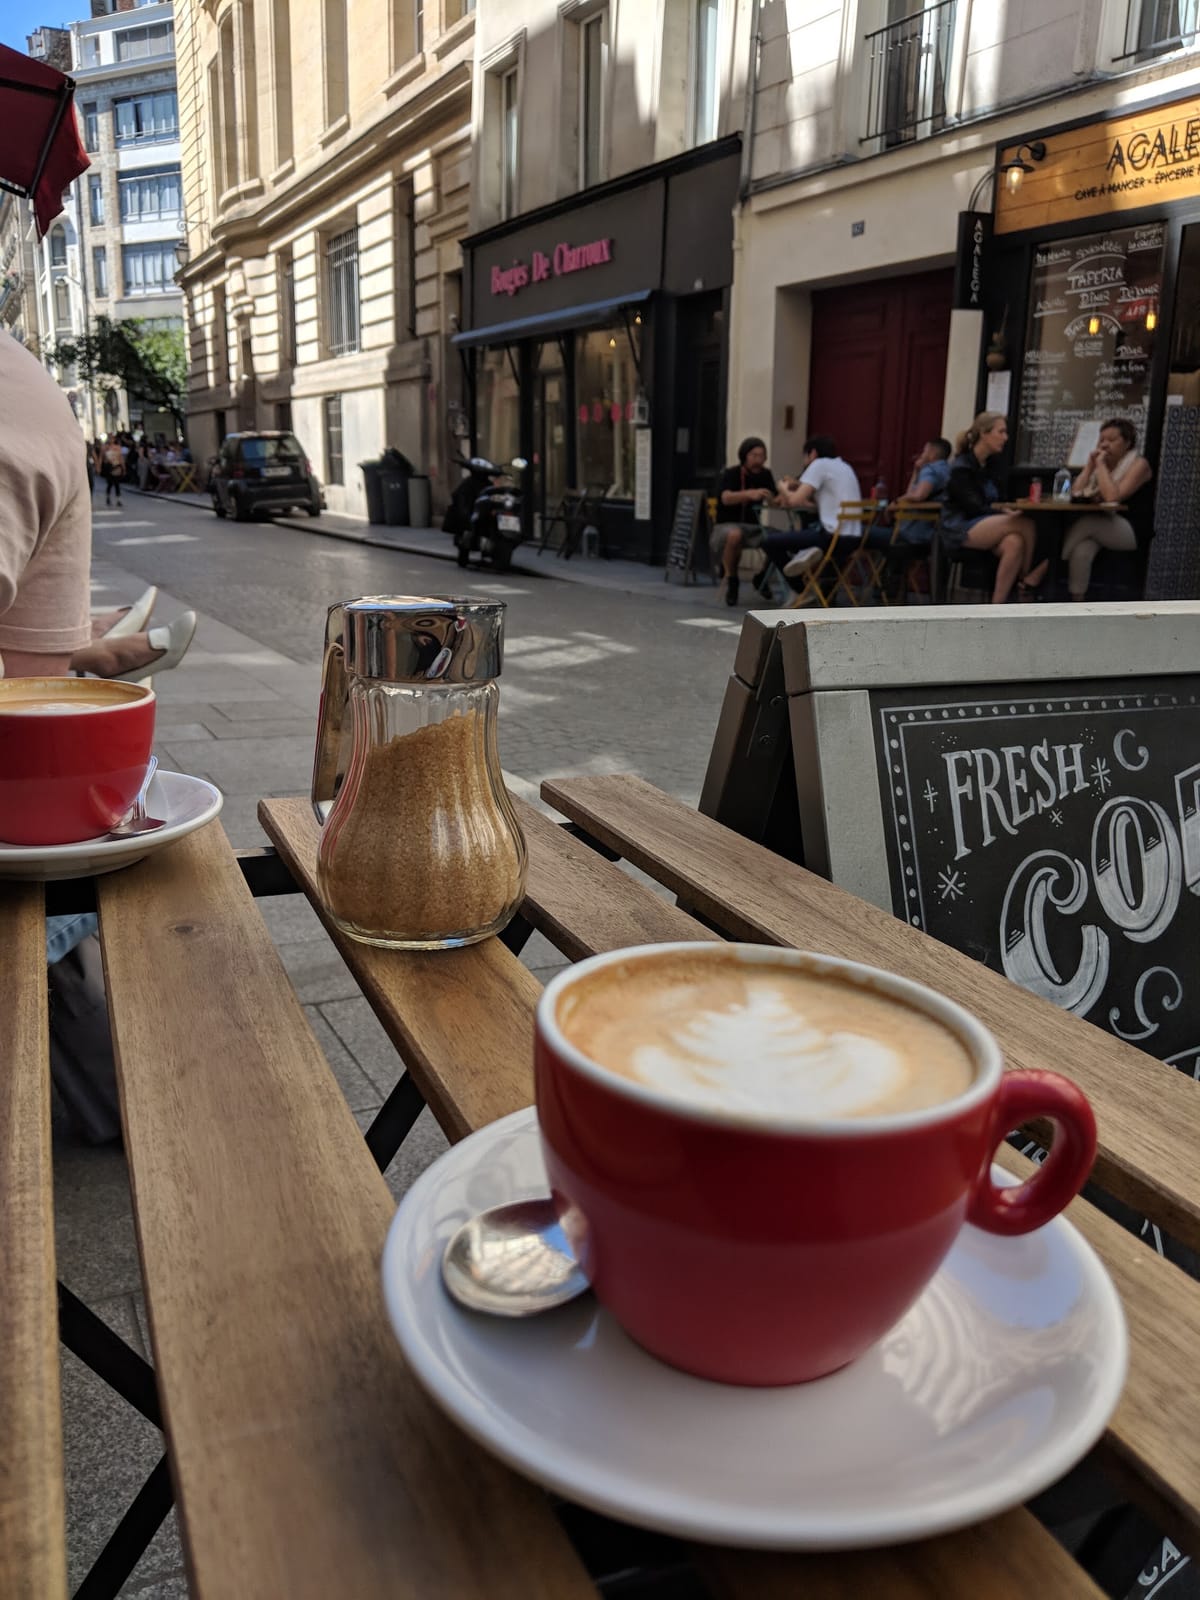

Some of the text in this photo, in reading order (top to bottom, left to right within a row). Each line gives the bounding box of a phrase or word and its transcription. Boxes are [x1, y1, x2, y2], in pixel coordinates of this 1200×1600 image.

[532, 252, 550, 282] De
[970, 218, 983, 303] AGALEGA
[941, 738, 1090, 861] FRESH
[1000, 763, 1200, 1020] CO
